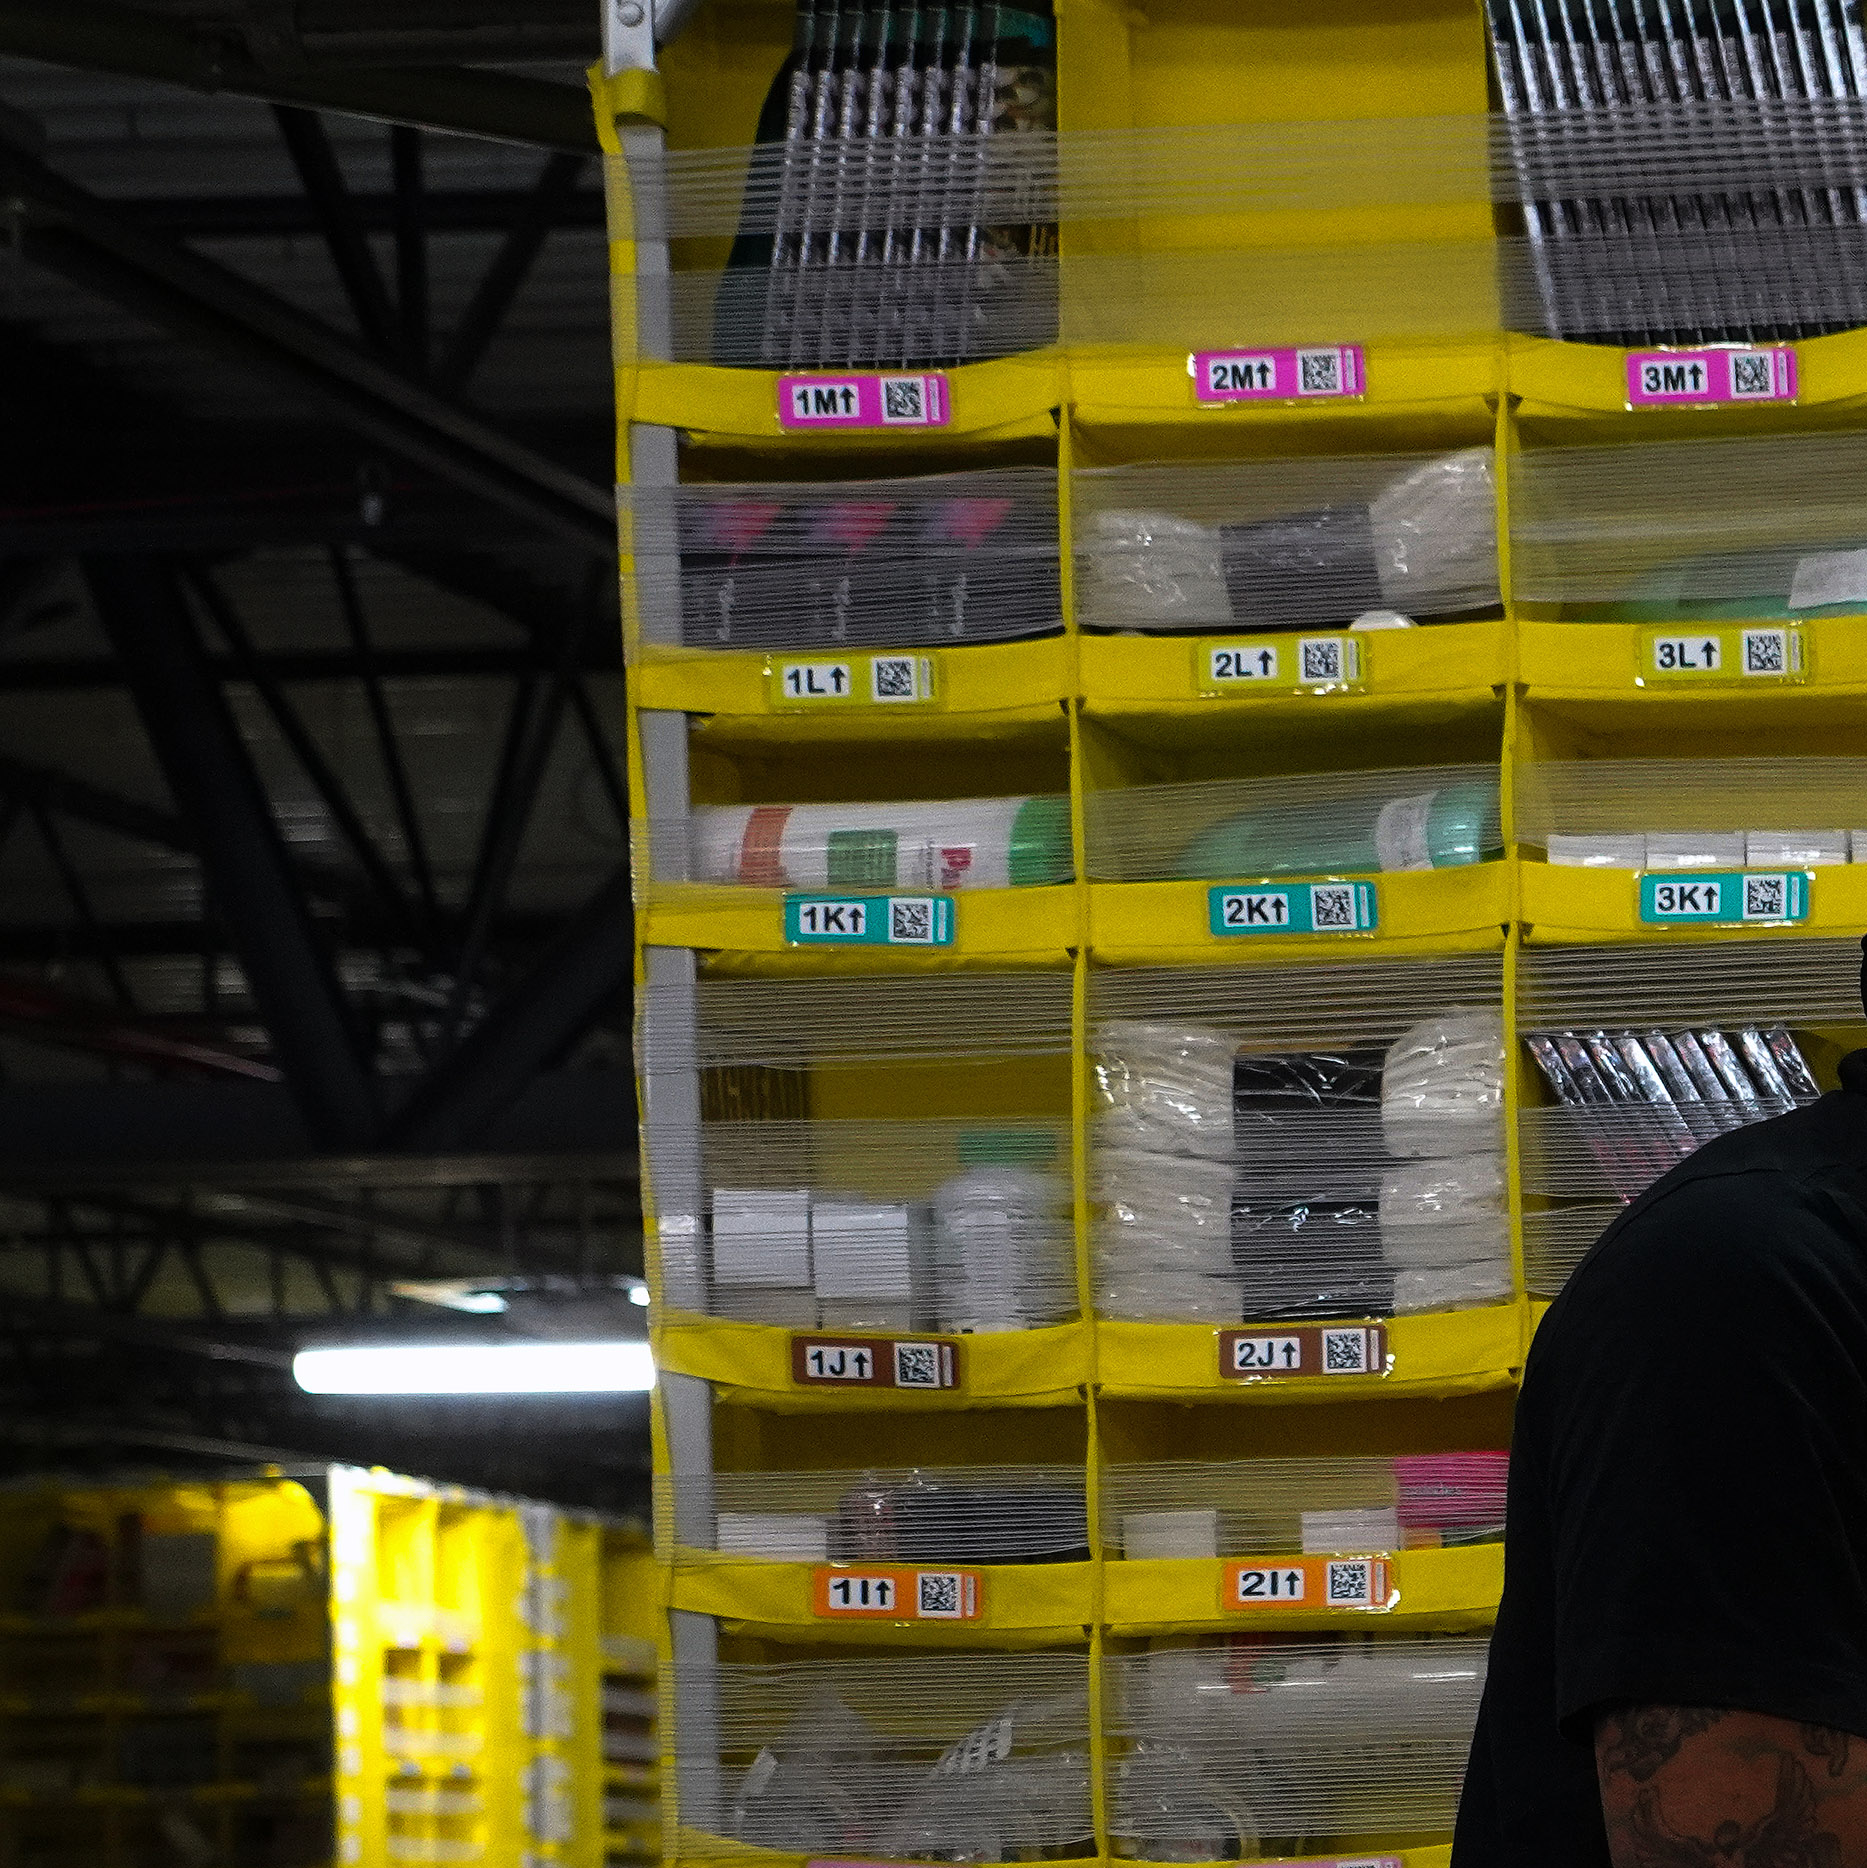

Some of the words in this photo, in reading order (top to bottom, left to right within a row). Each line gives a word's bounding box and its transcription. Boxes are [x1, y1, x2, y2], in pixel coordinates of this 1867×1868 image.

[1213, 364, 1253, 390] 2M
[1646, 366, 1685, 392] 3M
[797, 389, 837, 414] 1M
[1216, 653, 1252, 677] 2L
[1660, 643, 1696, 668] 3L
[788, 669, 825, 694] 1L
[1227, 898, 1269, 923] 2K
[1658, 886, 1700, 911] 3K
[804, 906, 845, 932] 1K
[811, 1351, 846, 1376] 1J
[1239, 1342, 1273, 1367] 2J
[834, 1580, 869, 1605] 1I
[1242, 1571, 1278, 1596] 2I
